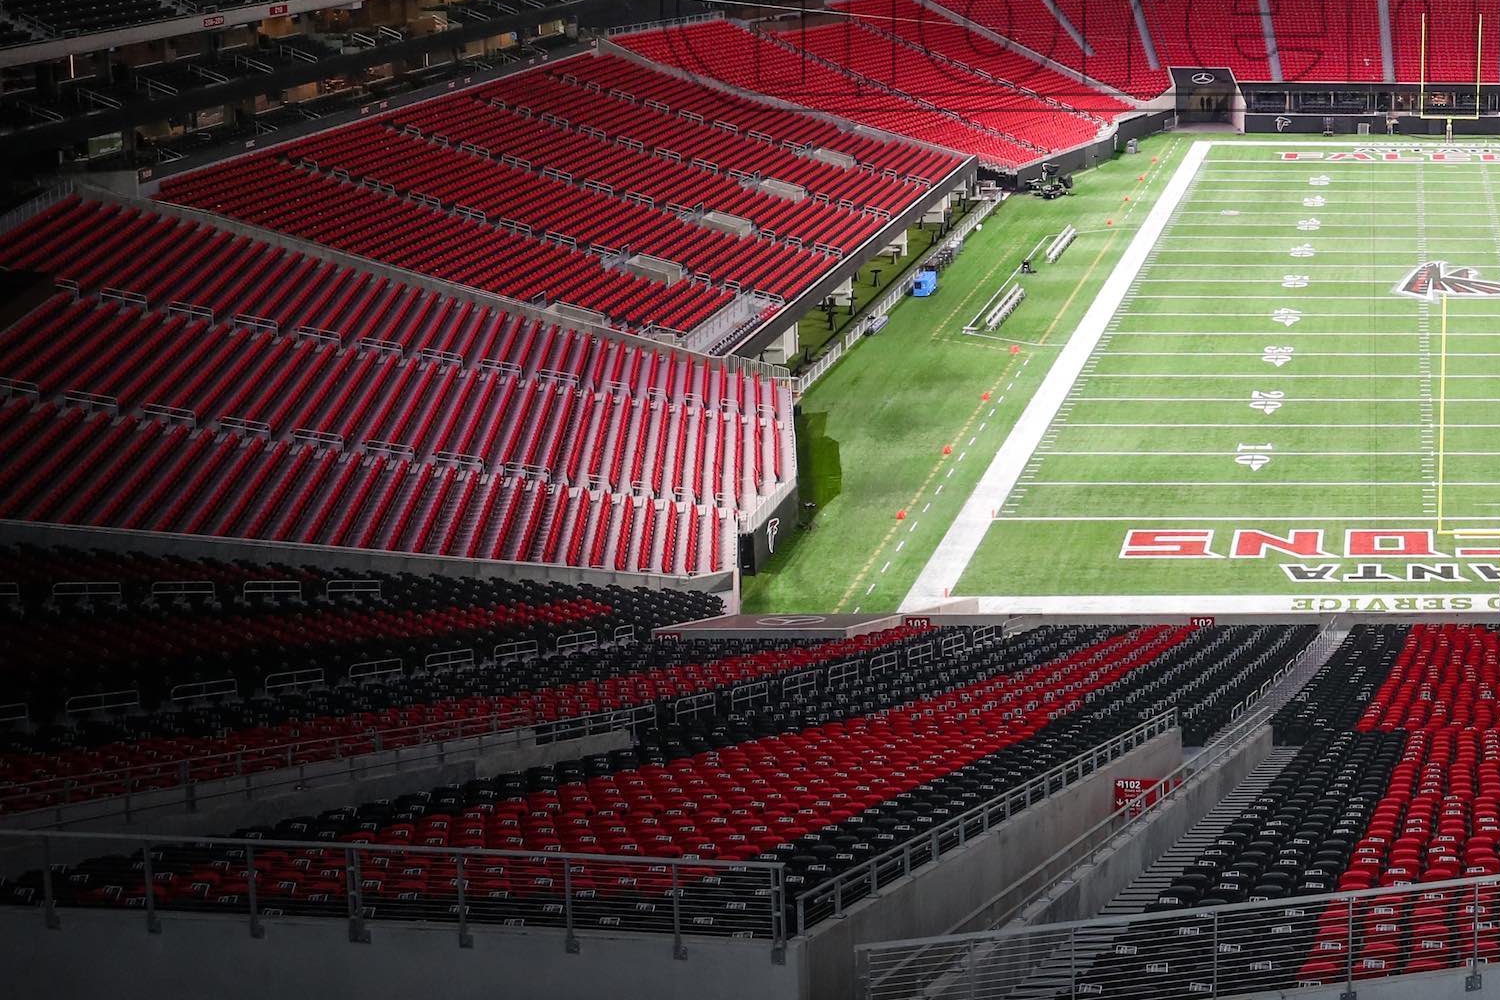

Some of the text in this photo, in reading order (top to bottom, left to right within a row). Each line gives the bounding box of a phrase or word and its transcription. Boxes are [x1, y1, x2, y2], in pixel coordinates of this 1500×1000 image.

[1262, 346, 1294, 362] 30
[1249, 390, 1285, 409] 20
[1234, 442, 1273, 465] 10
[1292, 597, 1473, 611] SERVICE
[907, 619, 929, 630] 103
[1193, 618, 1213, 628] 102
[1124, 780, 1141, 789] 102
